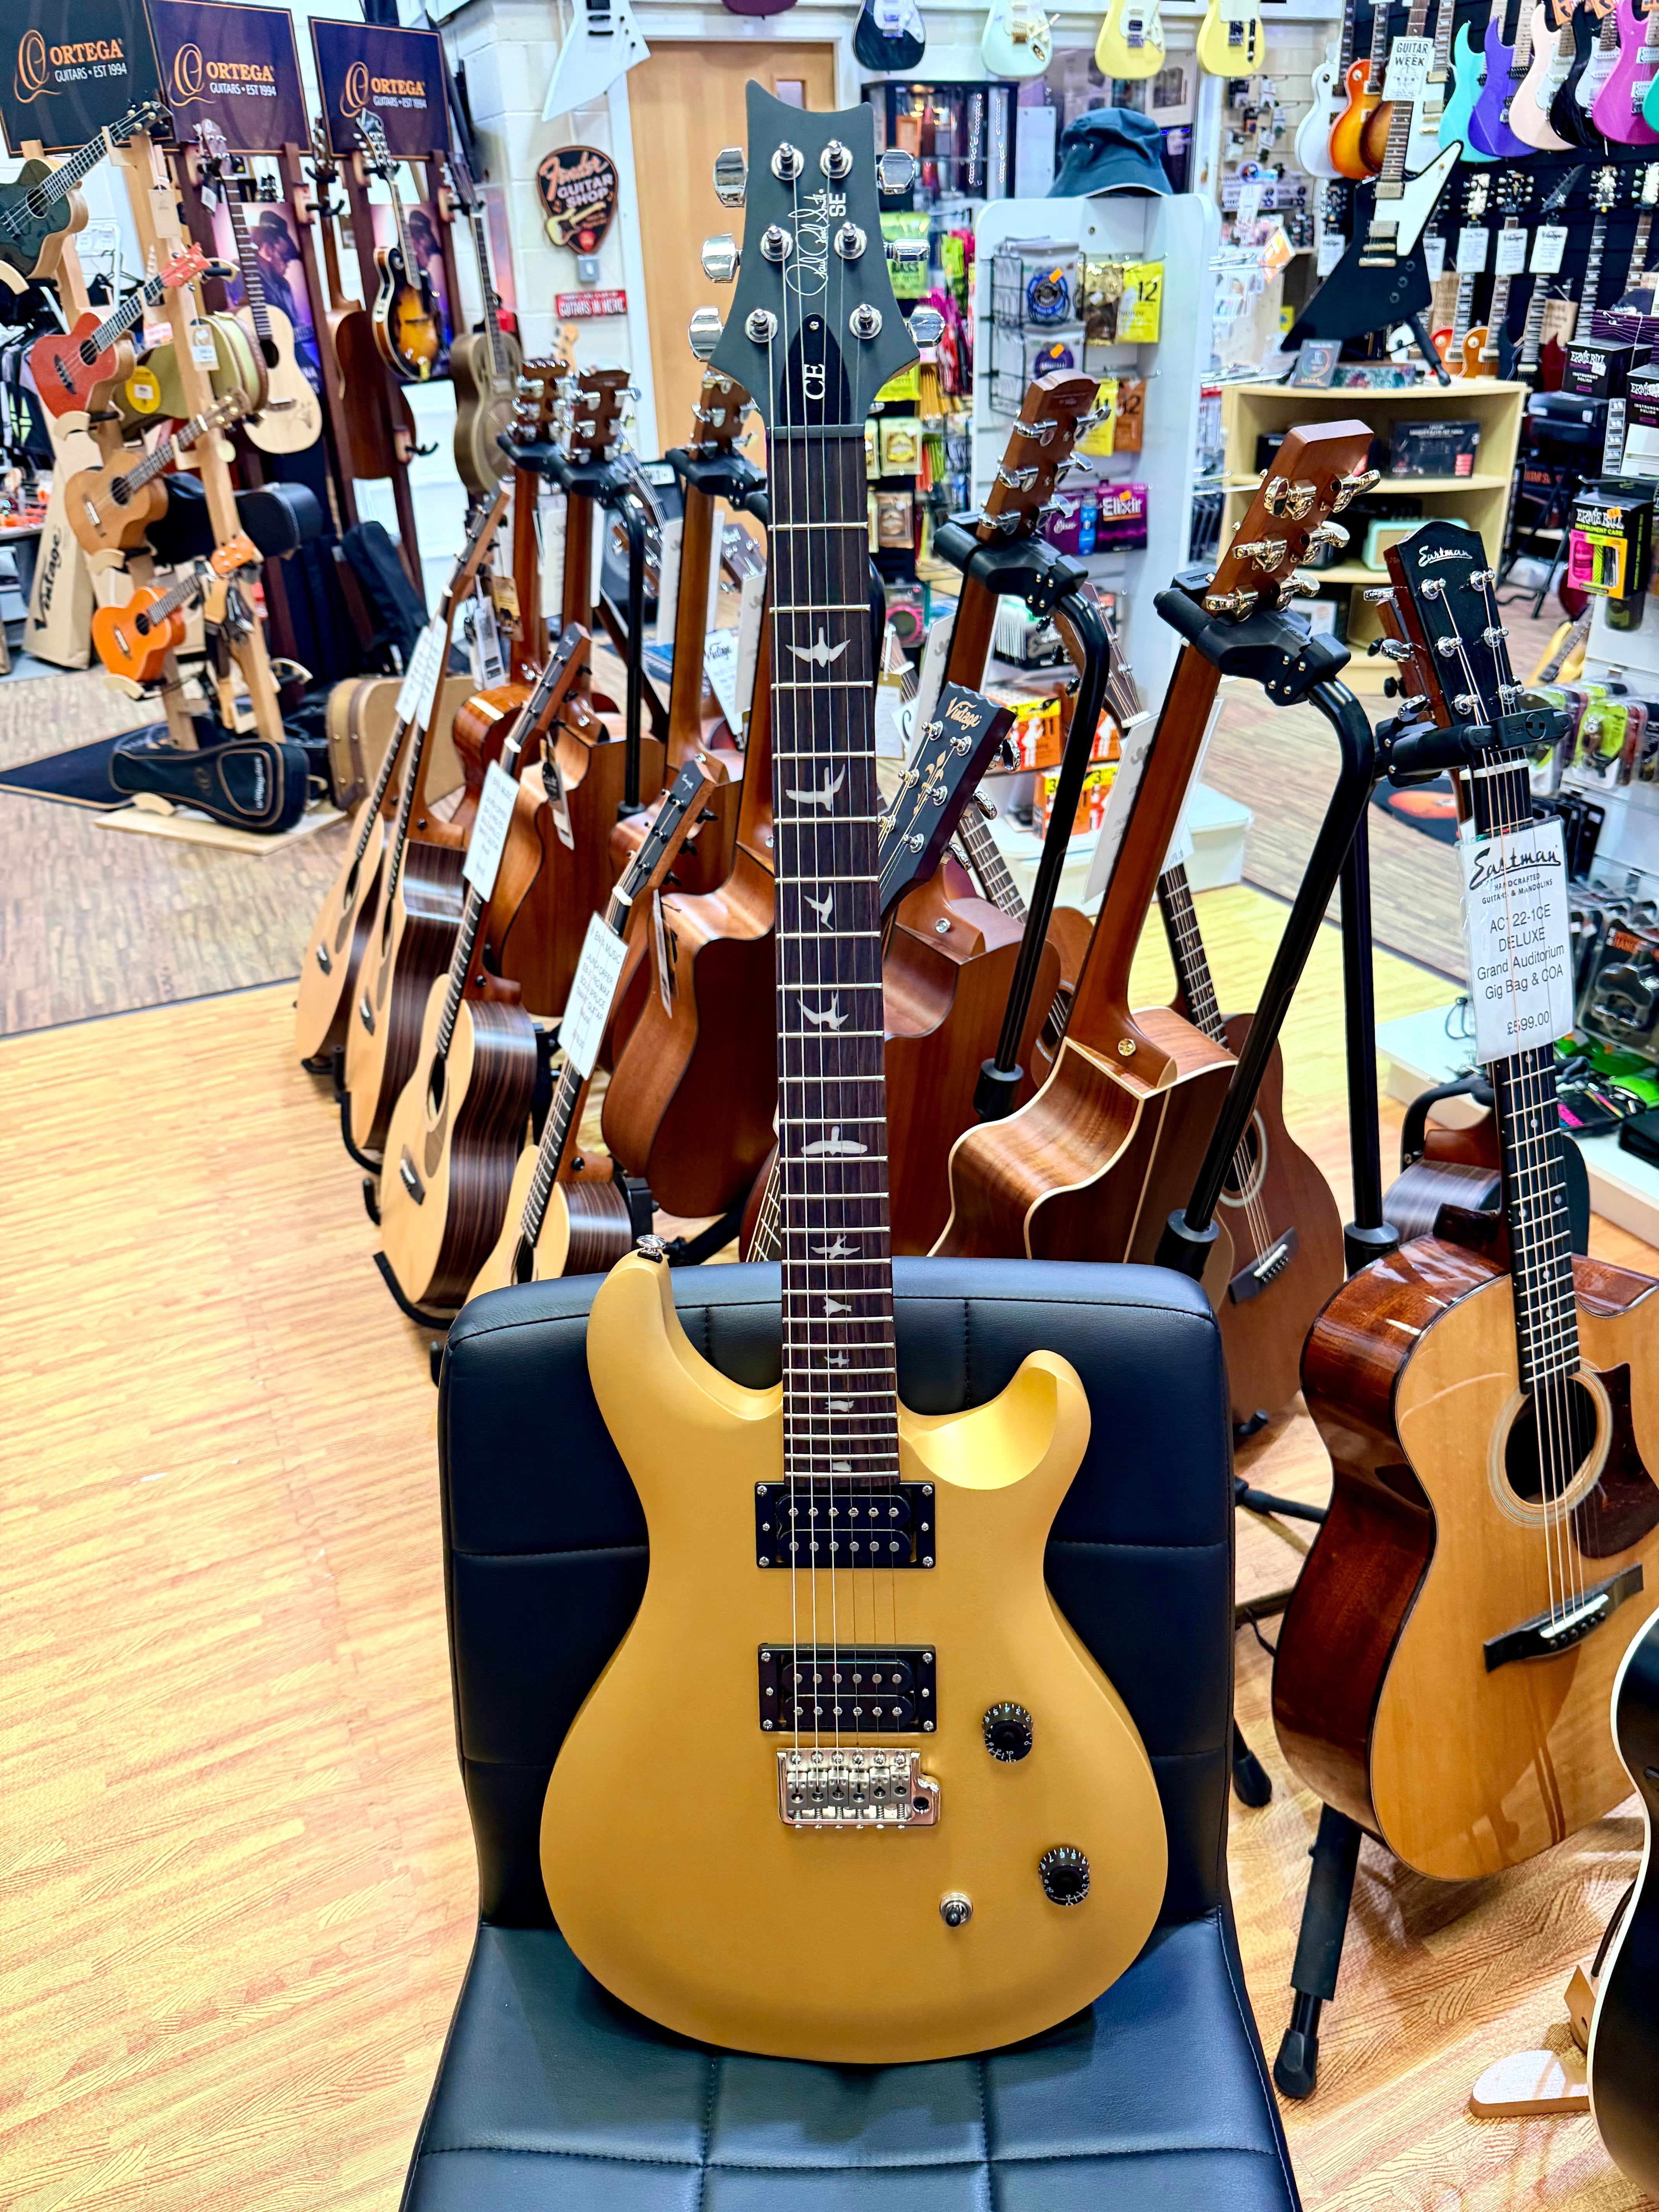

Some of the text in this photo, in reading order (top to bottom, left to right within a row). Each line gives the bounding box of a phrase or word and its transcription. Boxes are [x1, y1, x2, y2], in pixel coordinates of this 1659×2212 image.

[50, 39, 124, 65] ORTEGA
[1396, 42, 1428, 53] GUITAR
[55, 62, 127, 82] GUITARS EST 1994
[206, 62, 275, 82] ORTEGA
[1395, 57, 1425, 66] WEEK
[210, 82, 241, 95] GUITARS
[246, 84, 258, 96] EST
[371, 77, 426, 96] ORTEGA
[539, 151, 610, 201] Fender
[557, 174, 614, 199] GUITAR
[566, 187, 609, 208] SHOP
[829, 192, 846, 217] SE
[1139, 281, 1158, 302] 12
[1570, 350, 1590, 364] ERNIE
[804, 364, 825, 400] CE
[1103, 496, 1143, 517] Elixir
[1576, 507, 1602, 526] ERNIE
[1418, 545, 1473, 567] Eastman
[945, 697, 981, 730] Vintage
[1469, 847, 1561, 891] Eastman
[1518, 879, 1553, 895] MANDOLINS
[1490, 903, 1551, 934] AC22-1CE
[1499, 927, 1546, 952] DELUXE
[1477, 945, 1564, 981] Grand Auditorium
[1485, 963, 1563, 1000] Gig Bag & COA
[1507, 1011, 1550, 1036] £599.00
